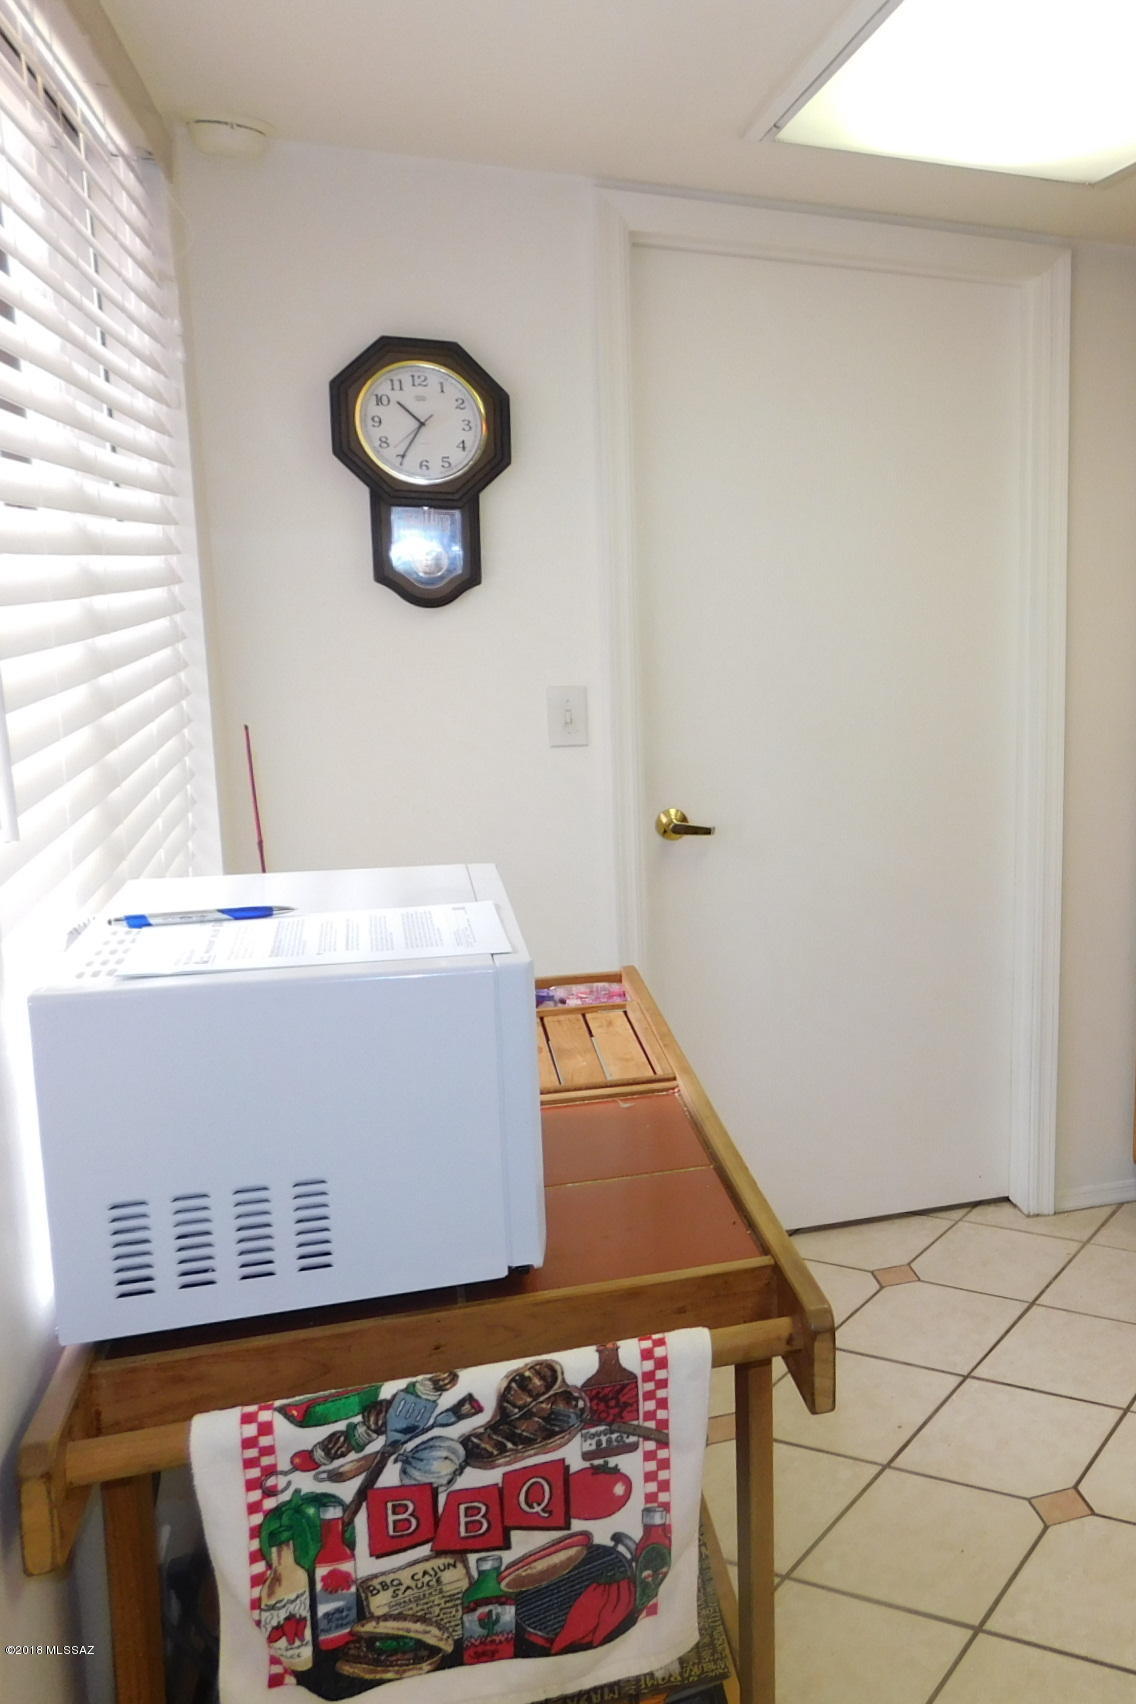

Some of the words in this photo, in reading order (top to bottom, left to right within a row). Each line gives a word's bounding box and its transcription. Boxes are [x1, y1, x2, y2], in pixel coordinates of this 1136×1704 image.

[388, 378, 404, 392] 11
[410, 374, 429, 388] 12
[438, 381, 446, 394] 1
[373, 393, 391, 407] 10
[455, 398, 467, 411] 2
[371, 415, 382, 428] 9
[461, 419, 473, 432] 3
[378, 436, 391, 449] 8
[456, 439, 467, 452] 4
[419, 459, 431, 471] 6
[441, 456, 452, 469] 5
[368, 1578, 403, 1597] BBQ
[411, 1560, 458, 1582] CAJUN
[391, 1577, 443, 1599] SAUCE
